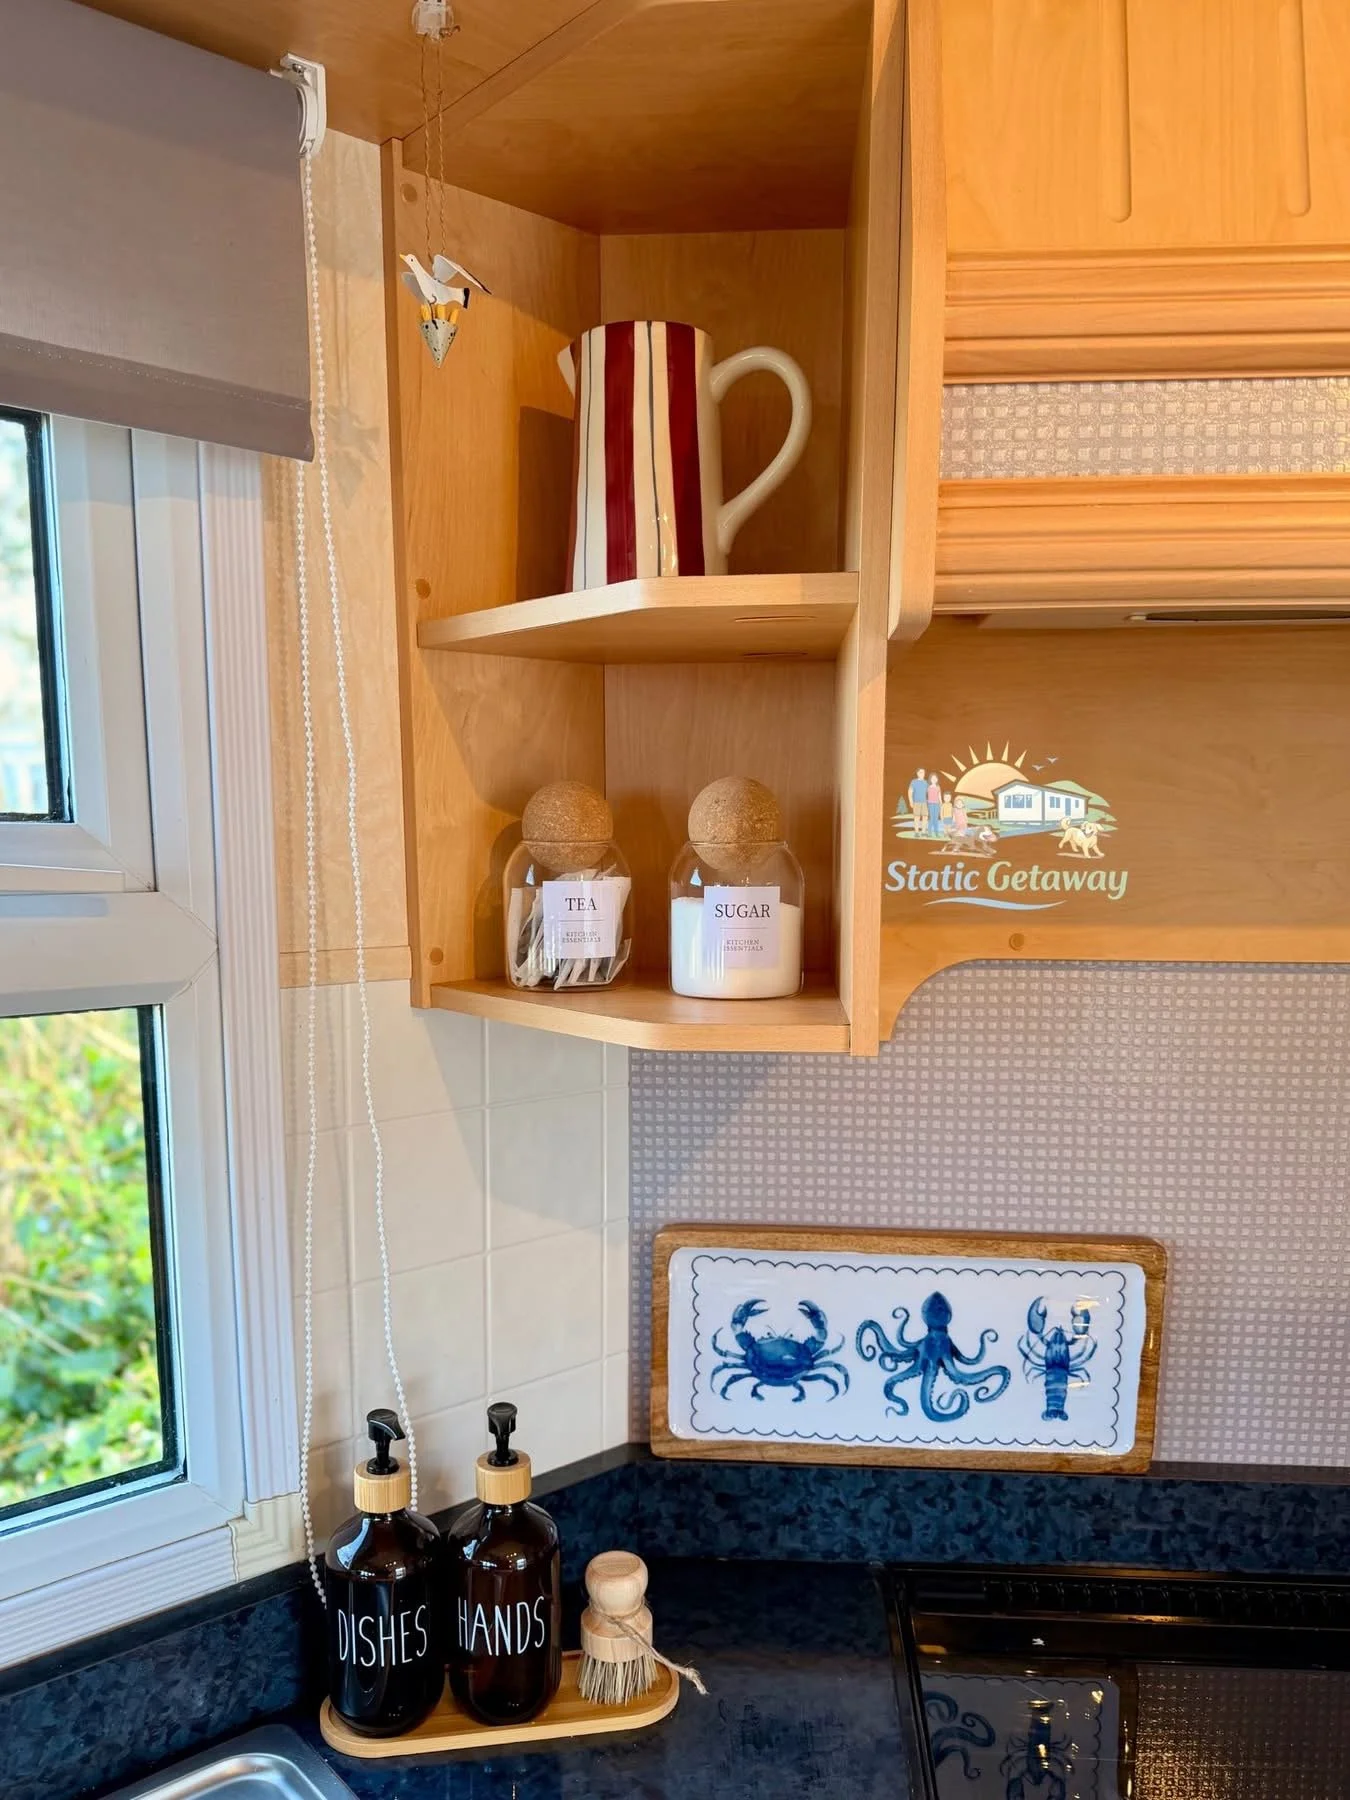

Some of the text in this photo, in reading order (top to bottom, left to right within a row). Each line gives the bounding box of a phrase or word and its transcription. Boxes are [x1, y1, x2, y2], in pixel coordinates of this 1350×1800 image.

[565, 897, 598, 912] TEA
[714, 904, 770, 919] SUGAR
[338, 1604, 427, 1667] DISHES
[458, 1596, 545, 1656] HANDS
